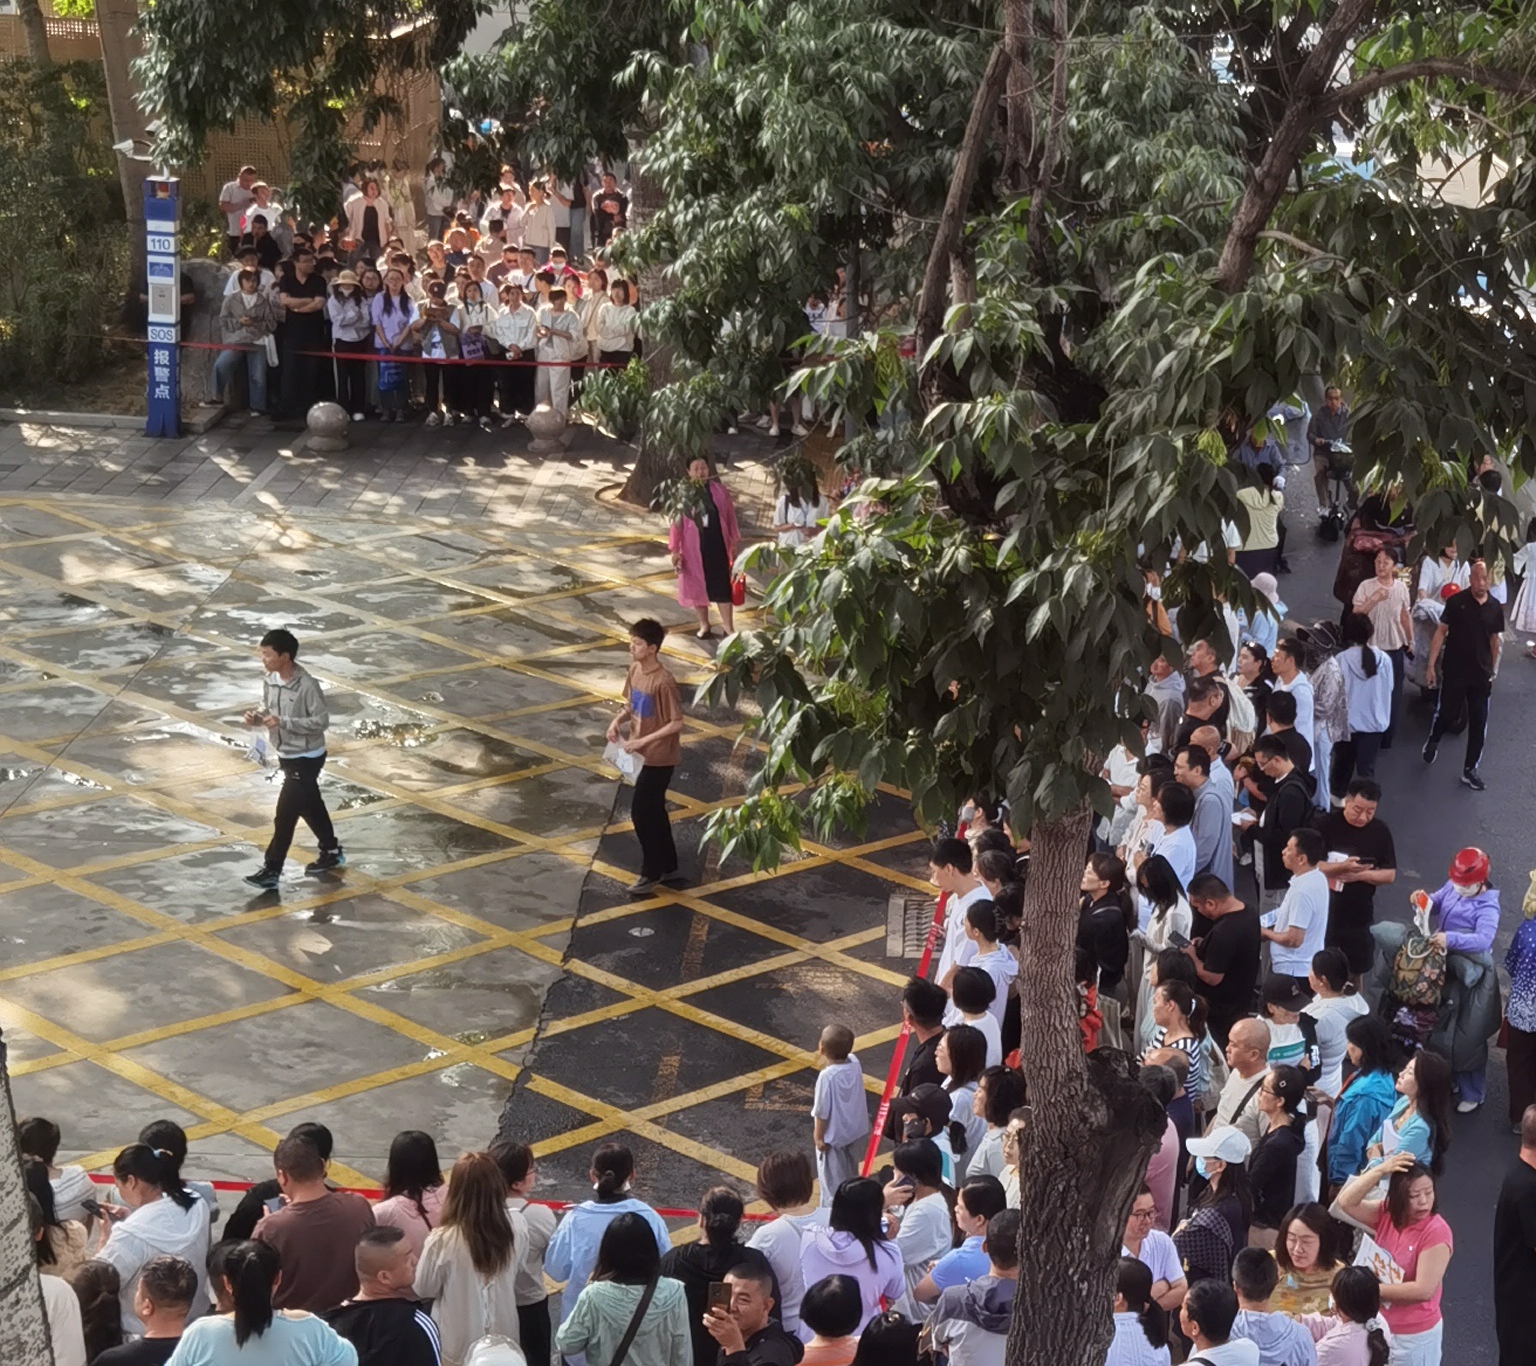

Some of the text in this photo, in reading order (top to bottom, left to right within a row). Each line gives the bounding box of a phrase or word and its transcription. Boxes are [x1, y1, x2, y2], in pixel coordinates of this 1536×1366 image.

[150, 238, 171, 251] 110
[150, 328, 173, 341] SOS
[154, 349, 170, 400] 报警点
